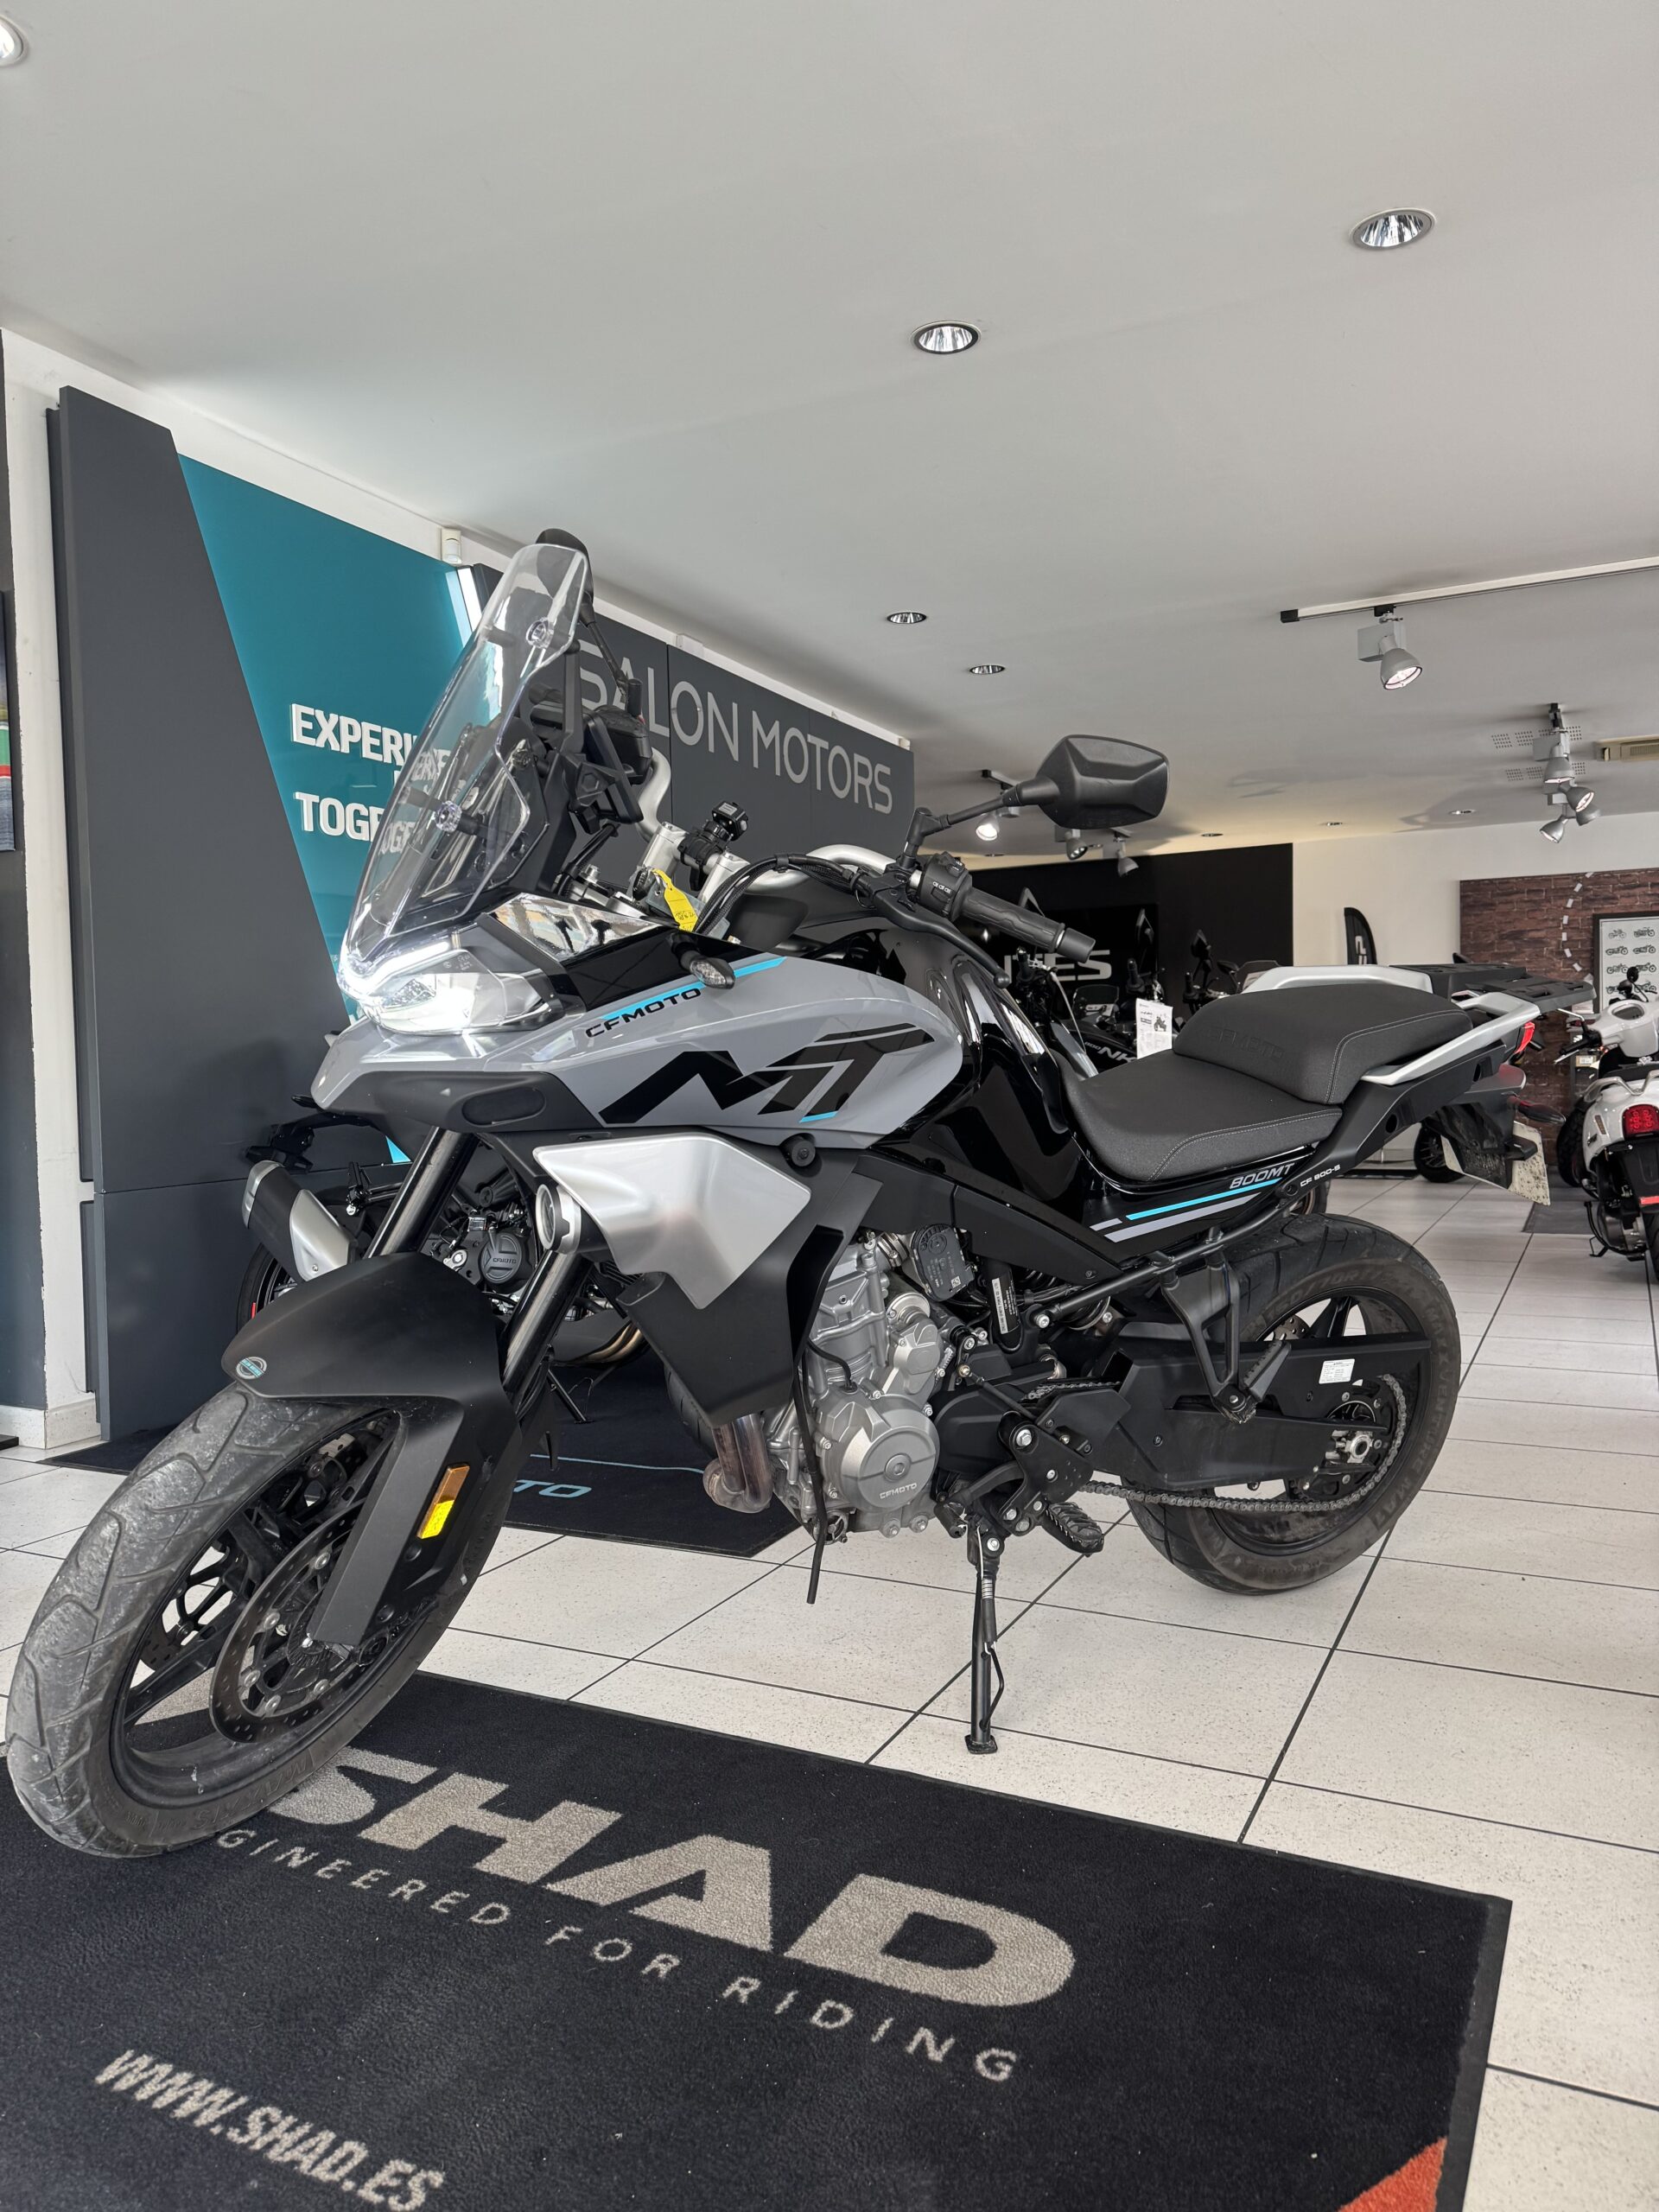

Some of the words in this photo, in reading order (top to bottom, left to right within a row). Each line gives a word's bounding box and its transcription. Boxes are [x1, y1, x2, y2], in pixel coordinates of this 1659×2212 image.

[752, 709, 893, 815] MOTORS
[585, 987, 702, 1039] CFMOTO
[598, 1023, 935, 1125] MT
[1229, 1162, 1295, 1190] 800MT
[1300, 1178, 1313, 1187] CF
[879, 1482, 918, 1499] CFMOTO
[544, 1925, 680, 1980] FOR
[721, 1975, 1017, 2082] RIDING
[94, 2050, 446, 2212] WWW.SHAD.ES
